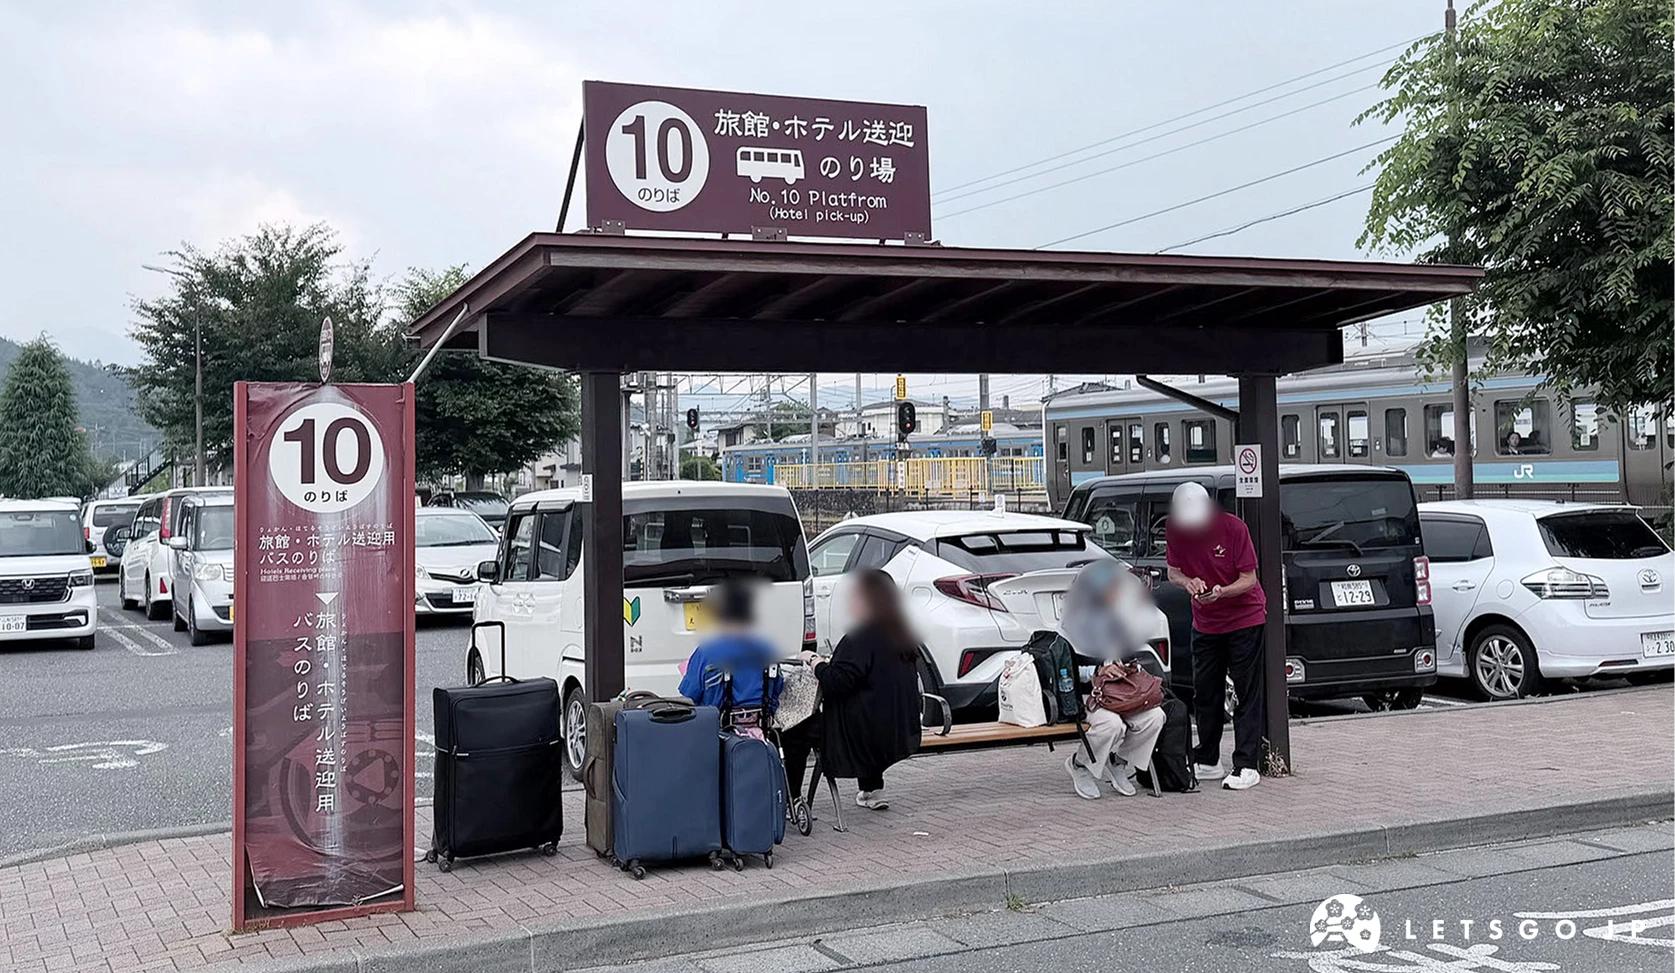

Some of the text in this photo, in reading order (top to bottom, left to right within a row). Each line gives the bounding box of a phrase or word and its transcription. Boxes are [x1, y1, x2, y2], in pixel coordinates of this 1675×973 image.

[714, 108, 915, 148] 旅館・ホテル送迎
[621, 115, 694, 183] 10
[819, 155, 897, 183] のり場
[637, 187, 681, 203] のりば
[808, 190, 887, 209] Platfrom
[769, 206, 870, 223] (Hotel pick-up)
[284, 417, 372, 485] 10
[1513, 464, 1534, 479] JR
[303, 489, 348, 503] のりば
[259, 531, 395, 550] 旅館・ホテル送迎用
[259, 549, 337, 565] バスのりば
[260, 567, 282, 575] Hotels
[284, 566, 317, 574] Receiving
[293, 611, 313, 722] バスのりば
[315, 610, 337, 812] 旅館・ホテル送迎用
